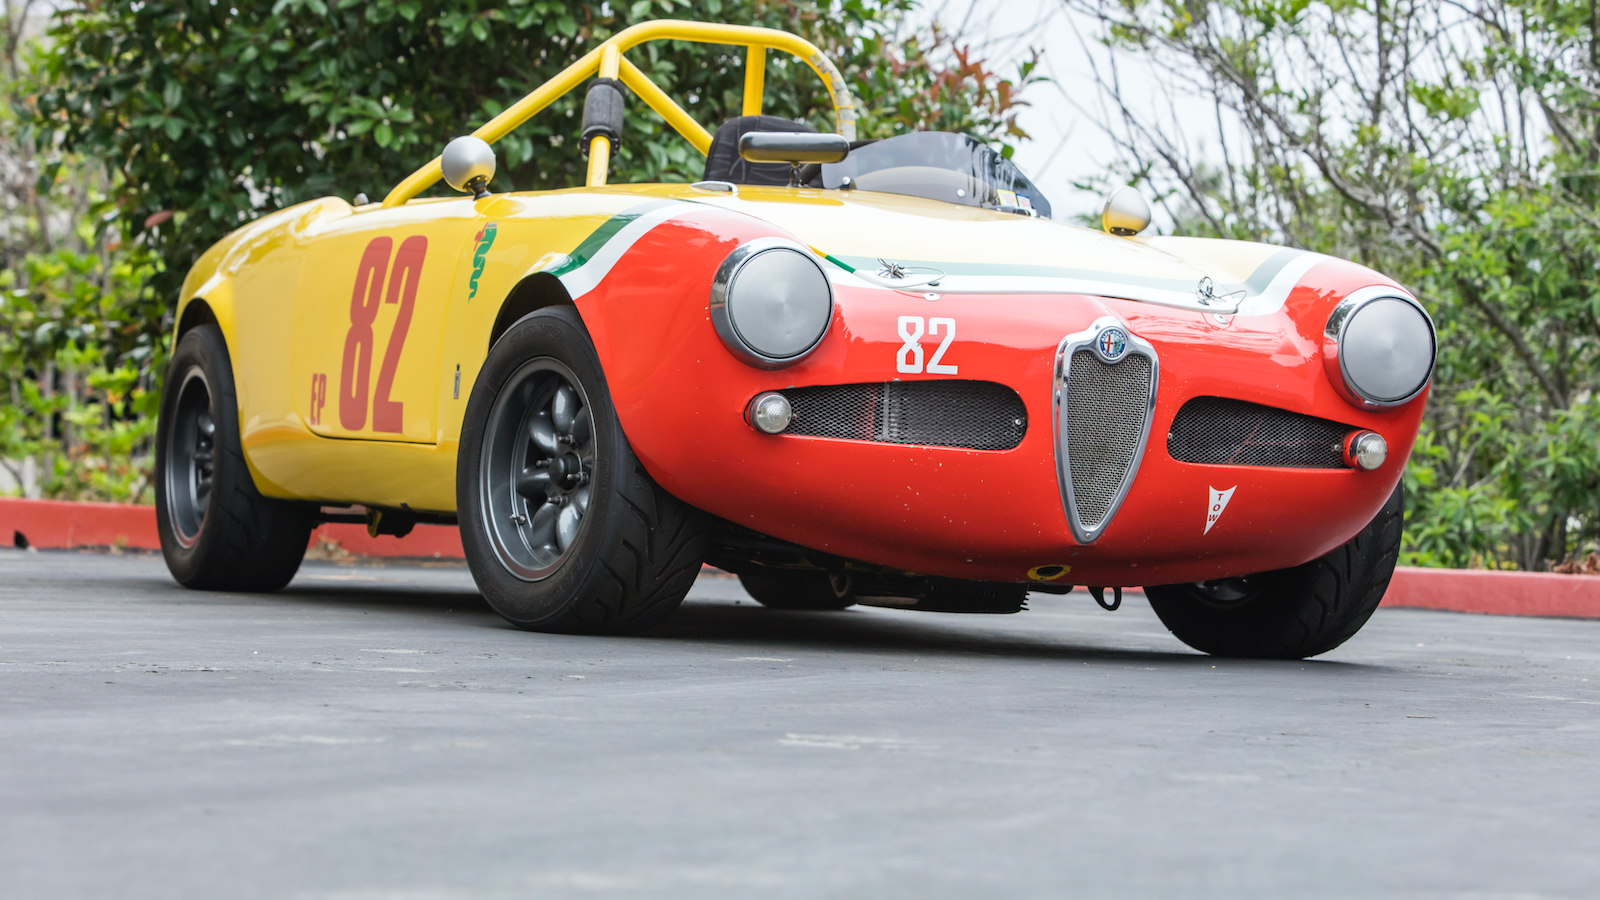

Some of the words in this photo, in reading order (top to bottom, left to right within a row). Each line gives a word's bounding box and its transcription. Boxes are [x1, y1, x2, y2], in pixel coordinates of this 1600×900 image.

[339, 235, 428, 434] 82
[896, 315, 958, 375] 82
[310, 373, 327, 426] EP
[1208, 493, 1224, 522] TOW
